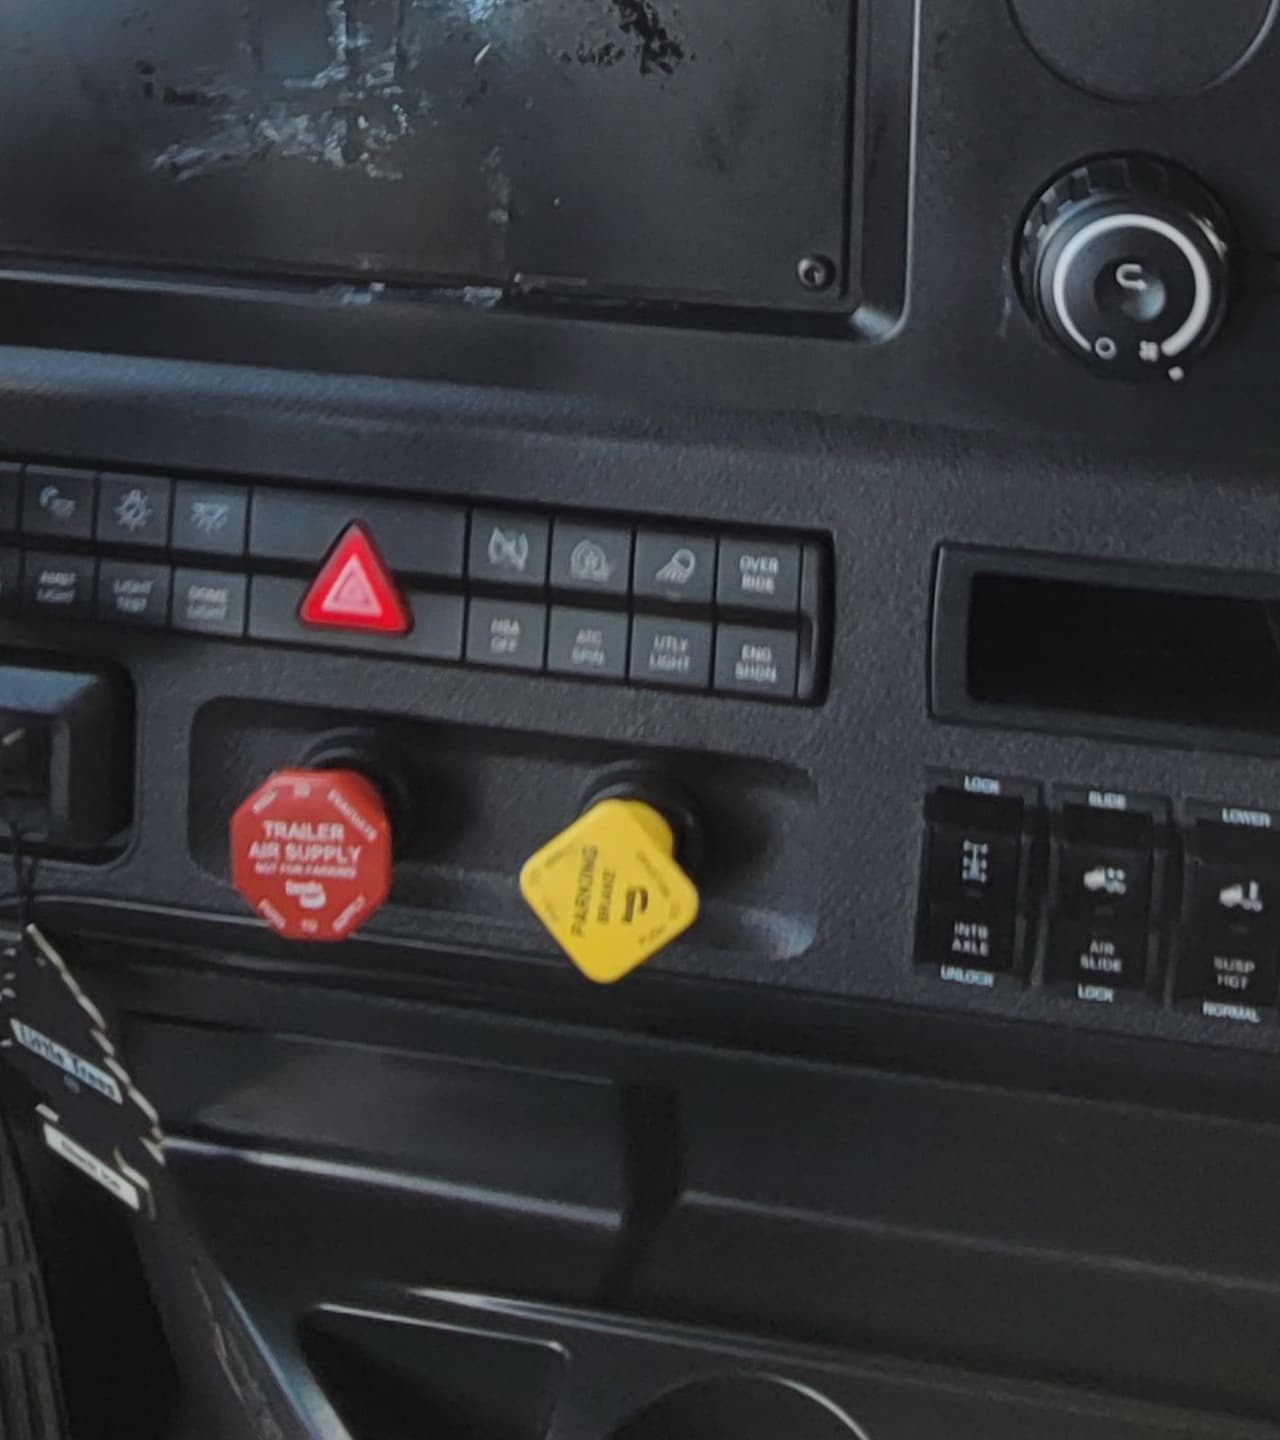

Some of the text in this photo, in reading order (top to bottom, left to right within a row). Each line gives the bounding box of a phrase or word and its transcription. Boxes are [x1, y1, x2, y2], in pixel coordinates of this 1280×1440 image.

[1221, 807, 1272, 828] LOWER
[263, 819, 345, 843] TRAILER
[248, 841, 362, 865] AIR SUPPLY
[570, 844, 599, 938] PARKING
